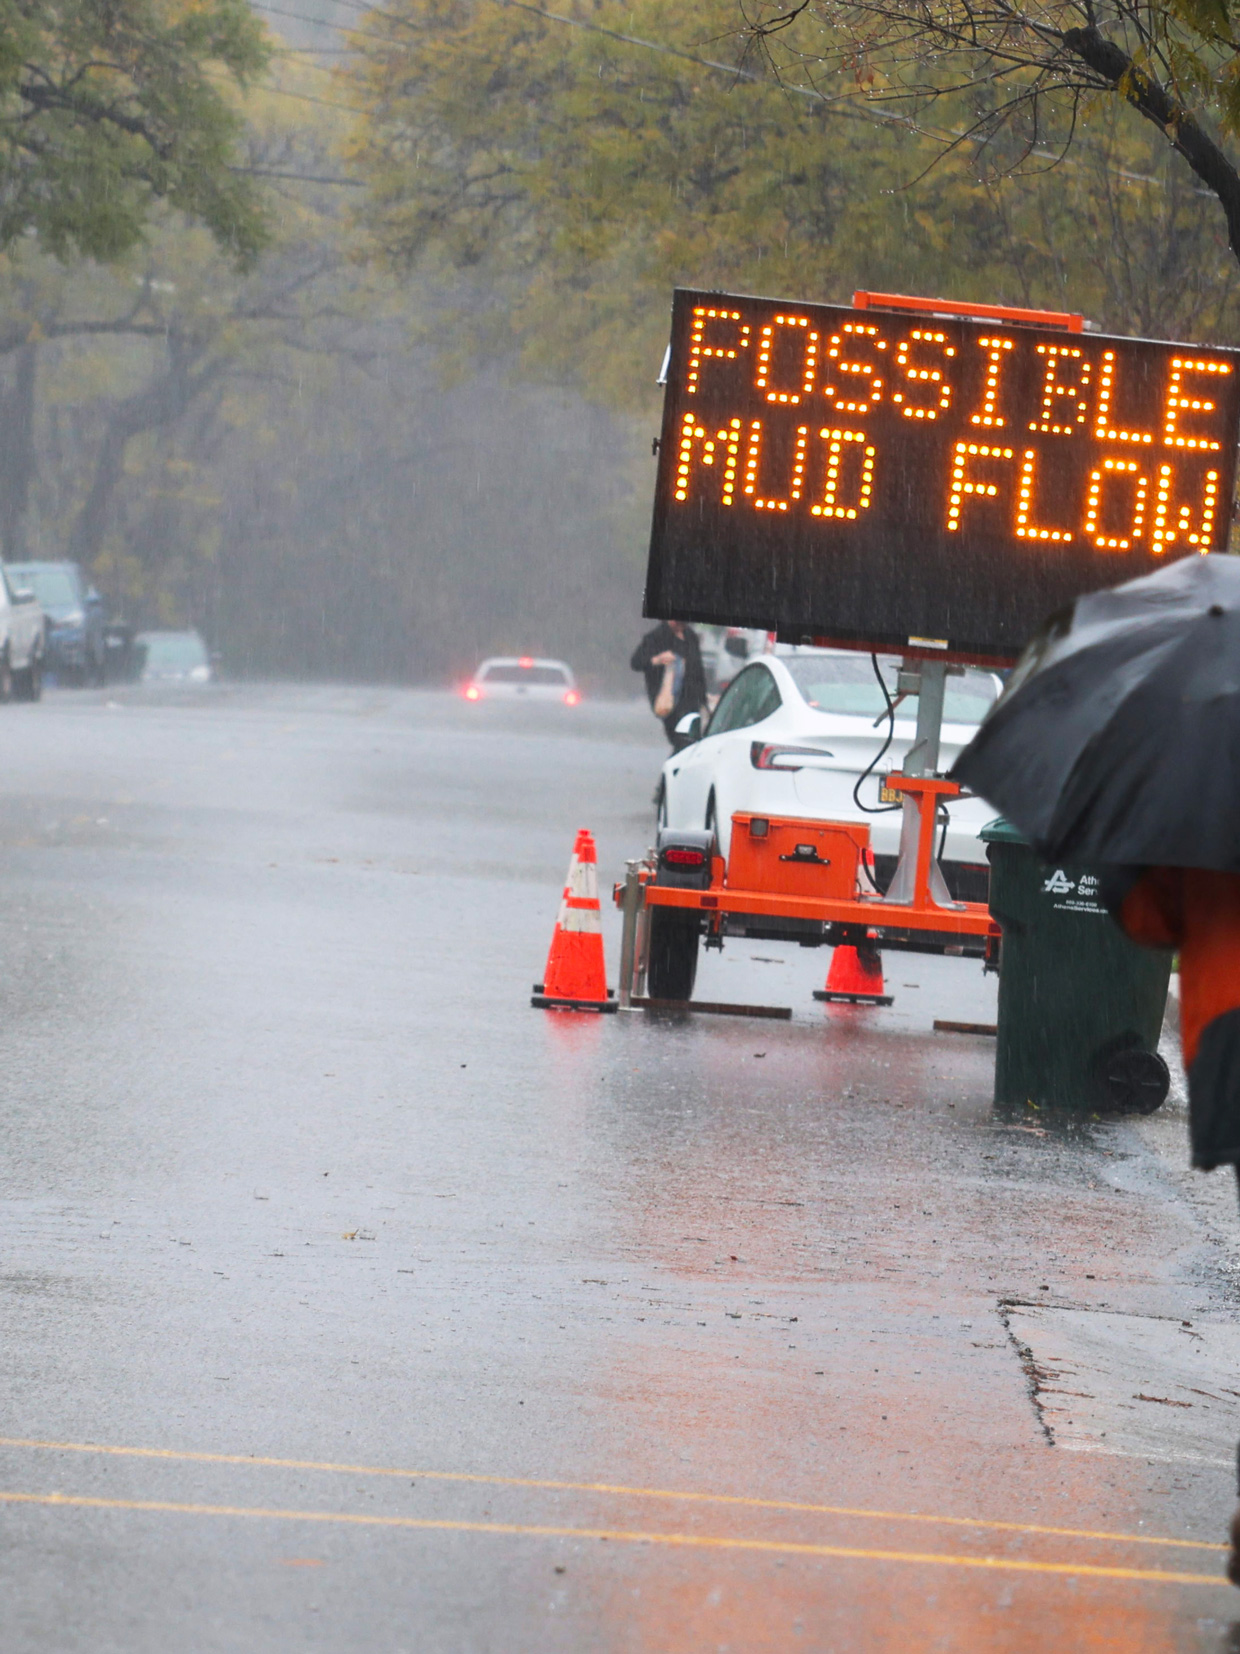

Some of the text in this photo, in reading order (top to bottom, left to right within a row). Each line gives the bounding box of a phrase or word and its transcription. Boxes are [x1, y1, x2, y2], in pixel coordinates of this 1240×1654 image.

[687, 307, 1232, 451] POSSIBLE
[674, 412, 1219, 555] MUD FLOW
[1079, 874, 1100, 885] Ath
